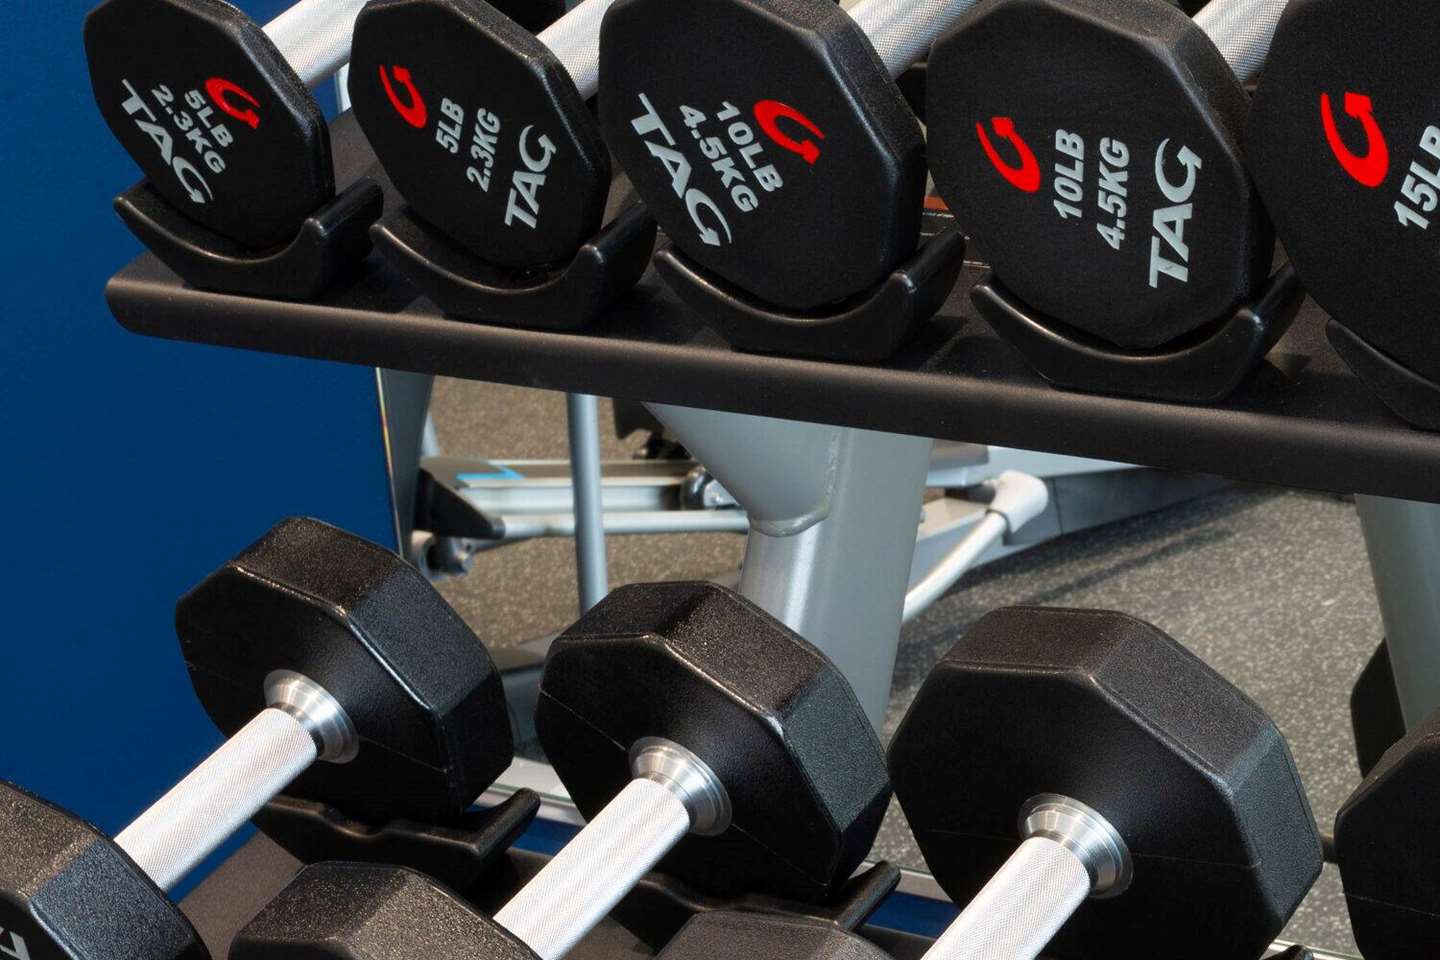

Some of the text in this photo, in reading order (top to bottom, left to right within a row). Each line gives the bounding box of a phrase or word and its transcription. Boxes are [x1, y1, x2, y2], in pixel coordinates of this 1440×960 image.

[121, 78, 214, 204] TAG
[151, 84, 226, 174] 2.3KG
[184, 89, 234, 147] 5LB
[435, 97, 464, 154] 5LB
[466, 108, 500, 192] 2.3KG
[679, 104, 759, 213] 4.5KG
[716, 101, 783, 192] 10LB
[504, 124, 557, 229] TAG
[630, 92, 733, 247] TAG
[1053, 128, 1084, 219] 10LB
[1096, 136, 1130, 250] 4.5KG
[1148, 137, 1202, 288] TAG
